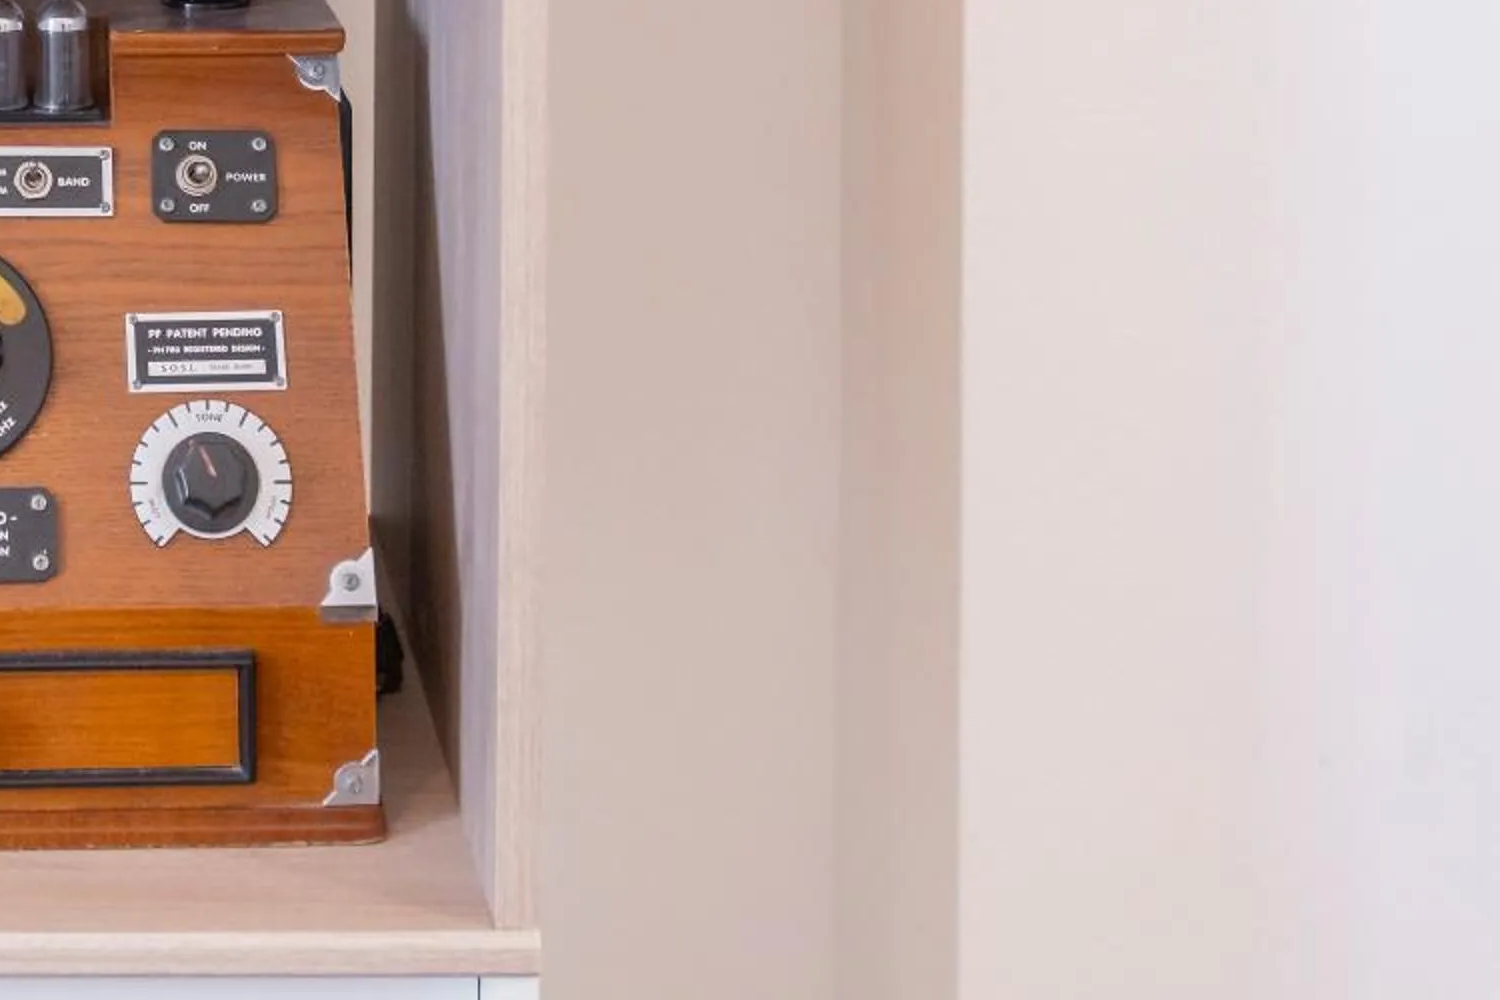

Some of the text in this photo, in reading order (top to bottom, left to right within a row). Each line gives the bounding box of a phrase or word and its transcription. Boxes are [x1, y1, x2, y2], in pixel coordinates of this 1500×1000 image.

[188, 140, 208, 151] ON
[57, 177, 91, 187] BAND
[225, 171, 267, 182] POWER
[189, 203, 210, 213] OFF
[165, 327, 208, 339] PATENT
[211, 326, 263, 338] PENDING
